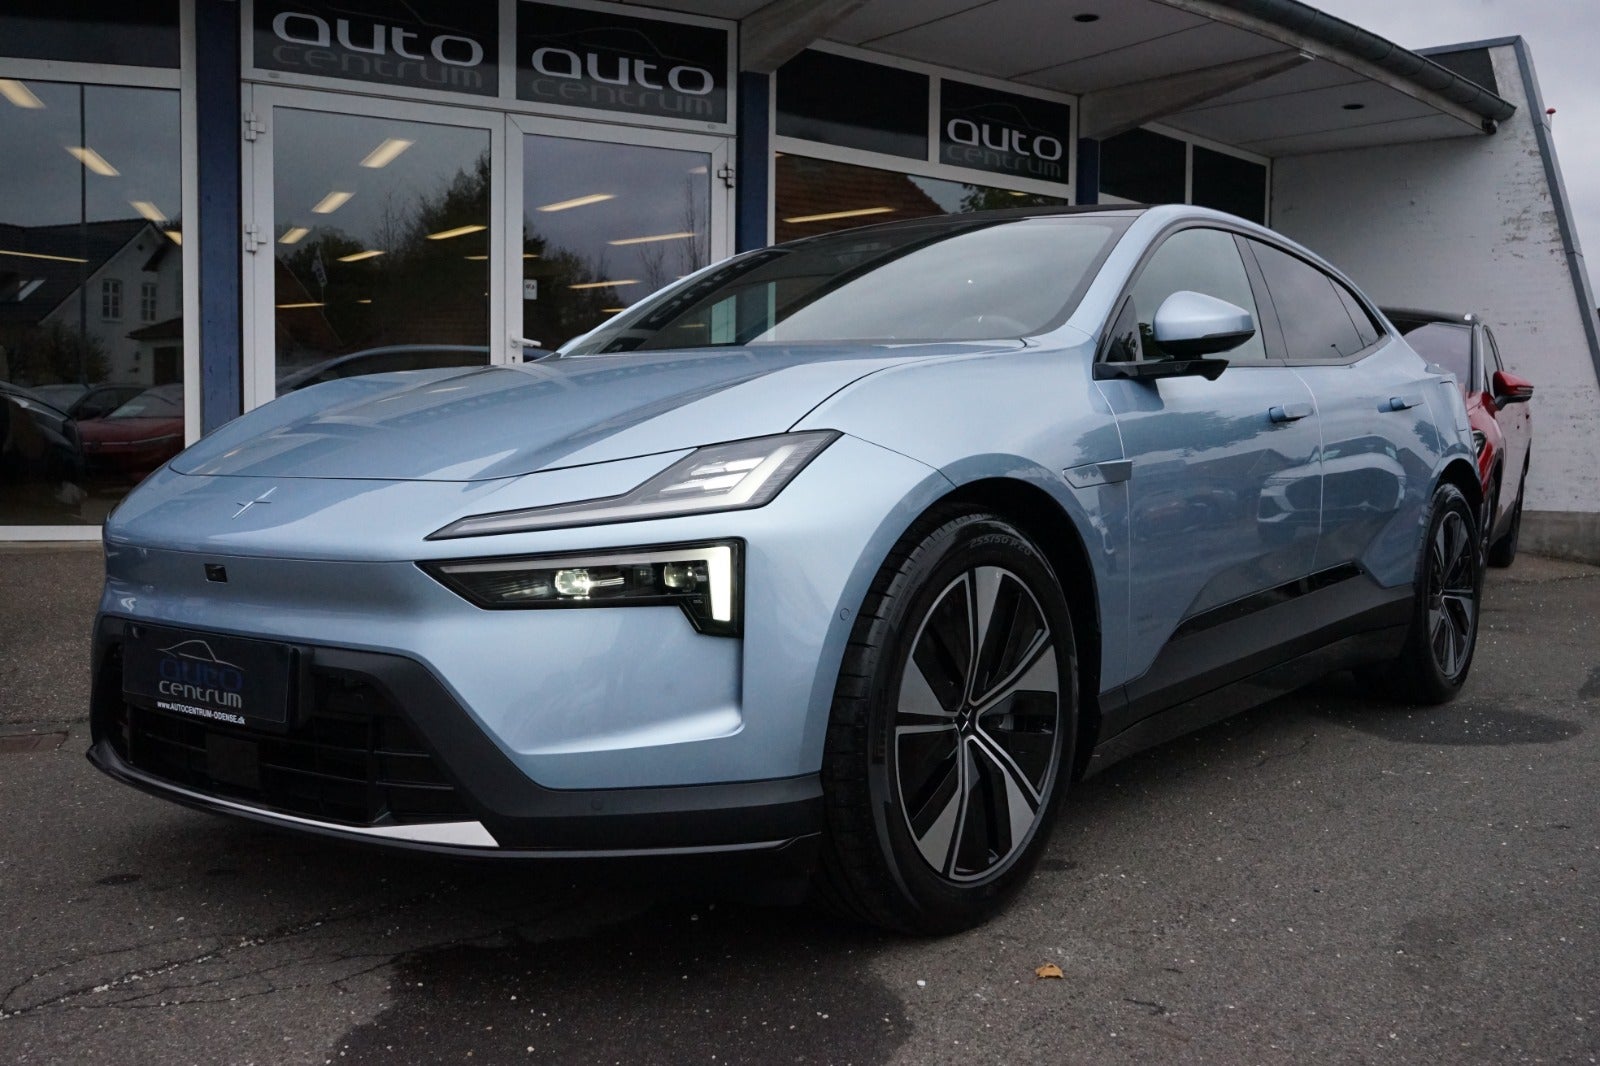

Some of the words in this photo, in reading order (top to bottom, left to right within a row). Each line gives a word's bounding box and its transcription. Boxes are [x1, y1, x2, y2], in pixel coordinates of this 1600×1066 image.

[272, 10, 484, 67] auto
[272, 44, 483, 89] centrum
[531, 46, 715, 96] auto
[531, 76, 714, 115] centrum
[946, 118, 1063, 161] auto
[946, 145, 1061, 178] centrum
[156, 701, 246, 725] www.AUTOCENTRUM-ODENSE.dk
[159, 680, 242, 709] centrum
